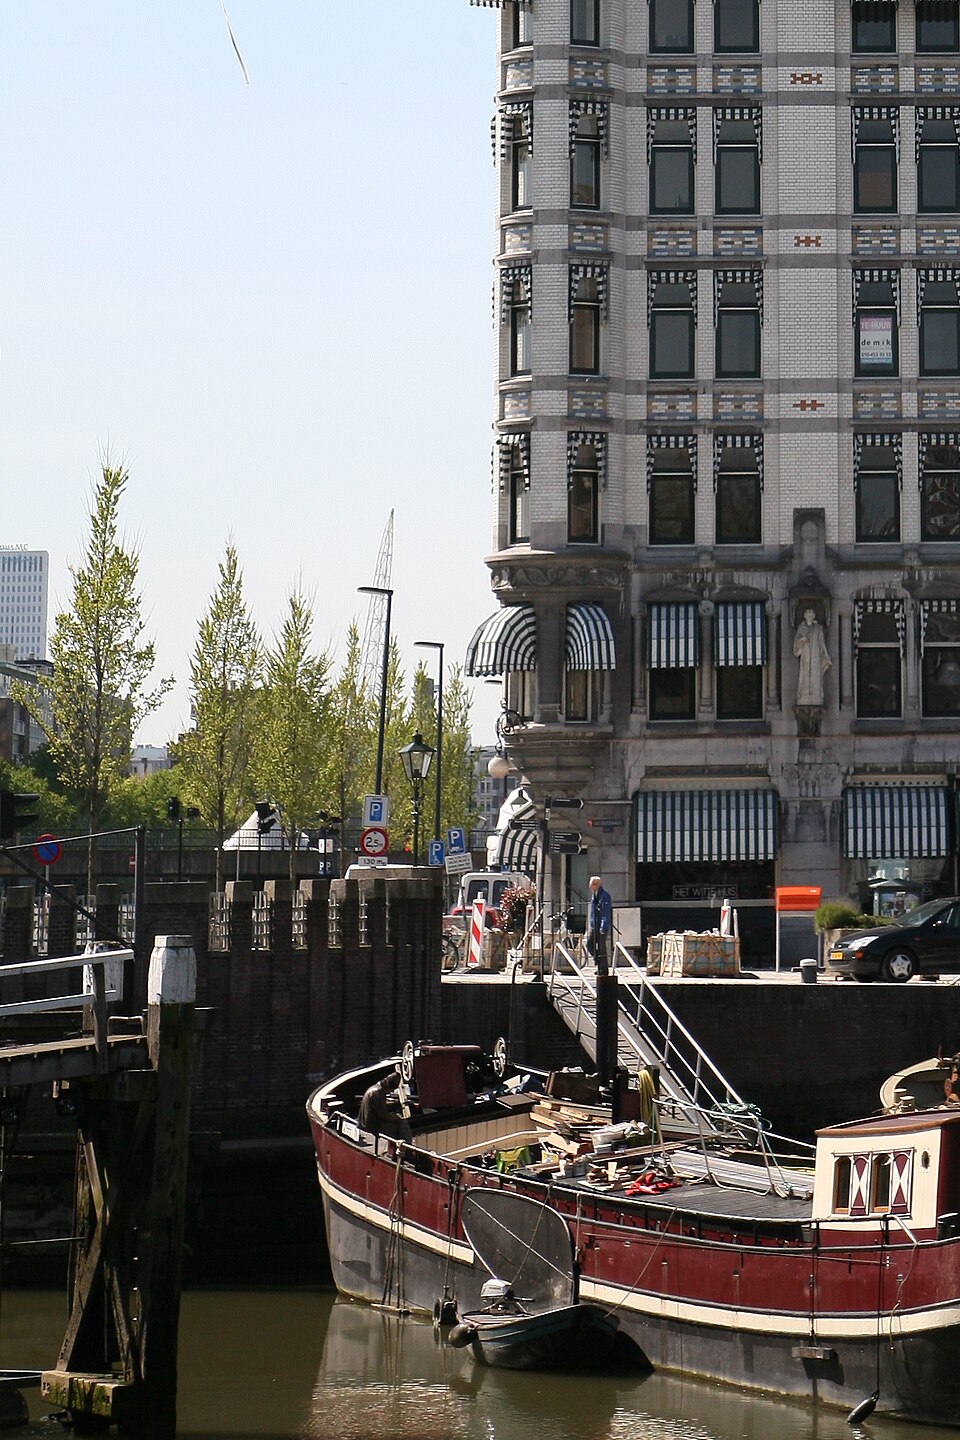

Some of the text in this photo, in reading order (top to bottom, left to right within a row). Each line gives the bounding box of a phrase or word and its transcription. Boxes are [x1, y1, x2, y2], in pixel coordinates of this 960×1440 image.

[860, 321, 892, 330] TE HUUR
[450, 830, 460, 844] P
[432, 843, 440, 856] P
[675, 887, 689, 897] HET
[692, 887, 717, 897] WITTE
